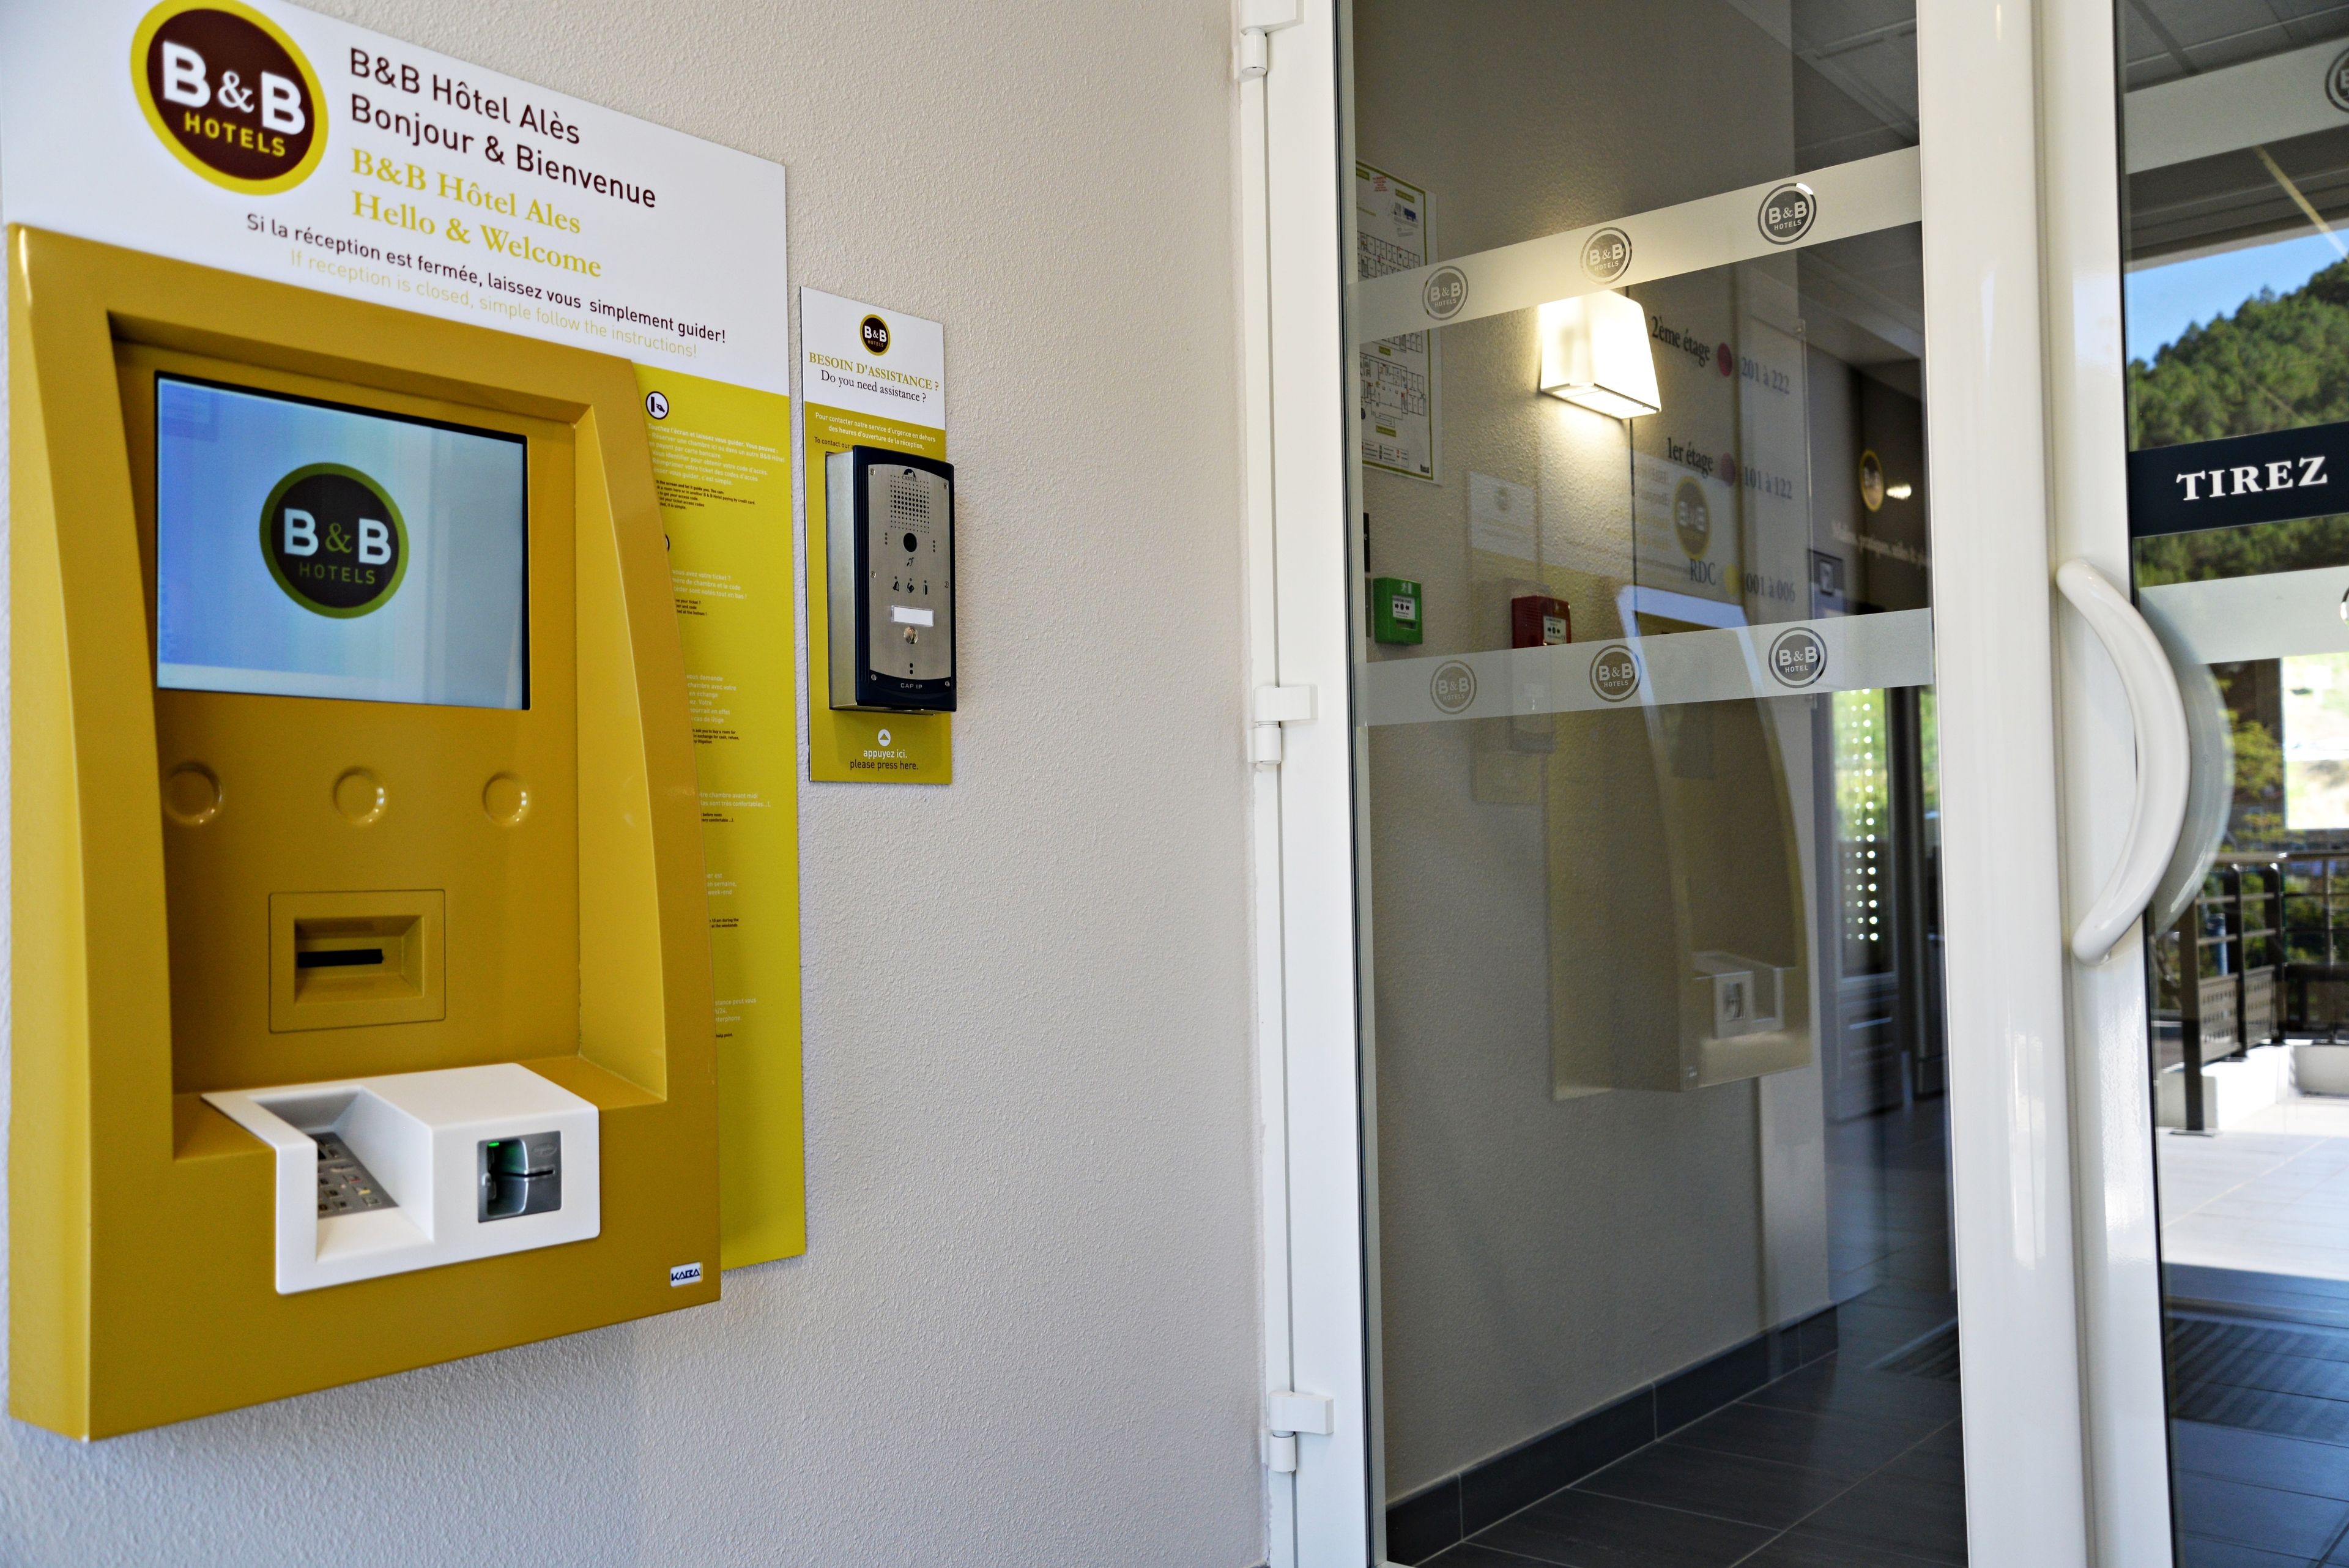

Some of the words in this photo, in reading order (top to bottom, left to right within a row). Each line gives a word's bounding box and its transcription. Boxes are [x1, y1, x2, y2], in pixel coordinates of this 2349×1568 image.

[161, 41, 305, 135] B&B
[351, 48, 420, 94] B&B
[433, 75, 510, 124] Hôtel
[519, 104, 579, 144] Alès
[184, 112, 286, 158] HOTELS
[352, 94, 474, 153] Bonjour
[484, 135, 505, 165] &
[517, 144, 655, 208] Bienvenue
[352, 148, 426, 190] B&B
[437, 173, 514, 215] Hôtel
[525, 199, 581, 234] Ales
[1768, 201, 1807, 225] B&B
[1774, 219, 1802, 231] HOTELS
[353, 191, 435, 234] Hello
[445, 218, 470, 244] &
[480, 225, 601, 277] Welcome
[1589, 243, 1624, 266] B&B
[1594, 260, 1619, 271] HOTELS
[247, 214, 264, 232] Si
[272, 219, 288, 237] la
[295, 227, 380, 260] réception
[386, 252, 412, 268] est
[418, 255, 482, 287] fermée,
[488, 272, 541, 299] laissez
[546, 290, 581, 308] vous
[590, 299, 674, 331] simplement
[678, 322, 725, 343] guider!
[1430, 281, 1461, 302] B&B
[291, 249, 302, 266] If
[308, 257, 392, 287] reception
[396, 274, 411, 292] is
[415, 281, 473, 308] closed,
[479, 296, 531, 320] simple
[535, 307, 581, 331] follow
[584, 319, 607, 337] the
[612, 325, 697, 357] instructions!
[1434, 298, 1457, 307] HOTELS
[864, 325, 886, 343] B&B
[1652, 316, 1680, 348] 2ème
[1683, 328, 1710, 367] étage
[1742, 357, 1759, 382] 201
[1772, 370, 1790, 395] 222
[809, 352, 853, 371] BESOIN
[856, 363, 932, 390] D'ASSISTANCE
[935, 381, 939, 391] ?
[821, 370, 836, 382] Do
[838, 377, 854, 387] you
[857, 381, 877, 392] need
[880, 385, 919, 401] assistance
[922, 392, 926, 403] ?
[815, 412, 827, 421] Pour
[829, 416, 853, 426] contacter
[887, 426, 911, 437] d'urgence
[919, 432, 935, 442] dehors
[839, 428, 856, 436] heures
[858, 431, 886, 442] d'ouverture
[1686, 442, 1712, 479] étage
[1745, 466, 1761, 489] 101
[1775, 477, 1792, 499] 122
[2176, 456, 2328, 501] TIREZ
[299, 562, 376, 585] HOTELS
[1690, 559, 1716, 586] RDC
[1746, 573, 1765, 596] 001
[1777, 581, 1796, 601] 006
[1778, 645, 1818, 666] B&B
[1438, 677, 1469, 694] B&B
[1599, 663, 1633, 681] B&B
[850, 760, 875, 770] please
[877, 762, 897, 771] press
[900, 760, 919, 770] here.
[863, 750, 894, 759] appuyez
[897, 749, 907, 758] ici.
[671, 1268, 700, 1281] KABA
